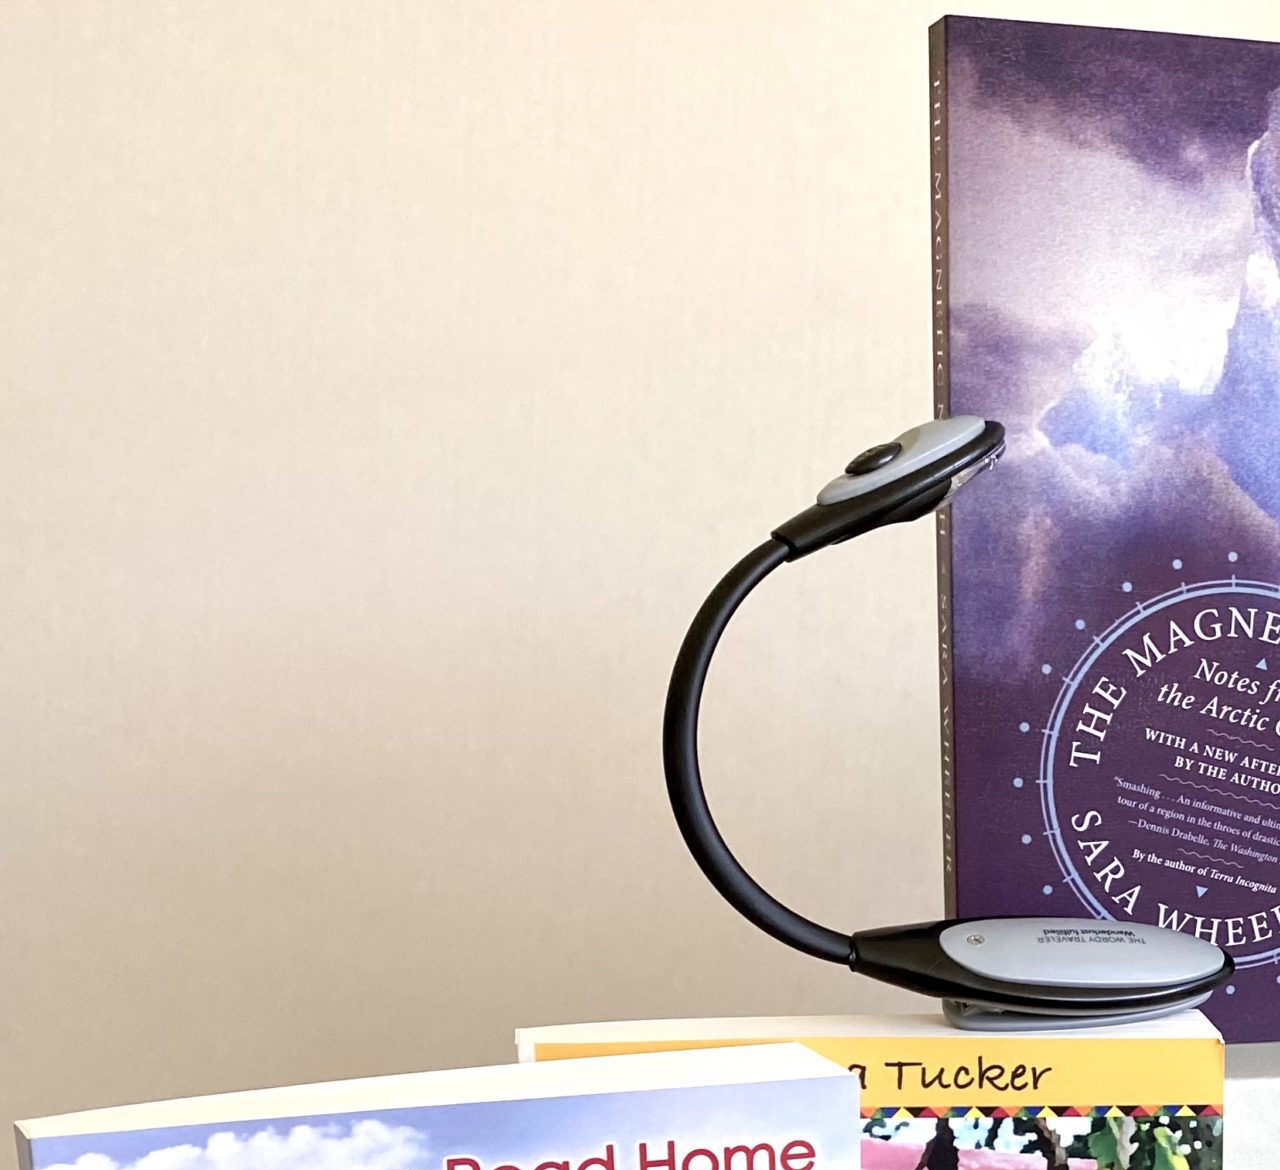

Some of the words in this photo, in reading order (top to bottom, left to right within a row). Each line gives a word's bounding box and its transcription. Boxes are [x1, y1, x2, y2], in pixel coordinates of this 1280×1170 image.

[1193, 658, 1260, 695] Notes
[1069, 676, 1127, 768] THE
[1157, 683, 1196, 710] the
[1199, 696, 1270, 731] Arctic
[1145, 728, 1187, 750] WITH
[1189, 741, 1199, 754] A
[1203, 744, 1238, 763] NEW
[1174, 755, 1195, 771] BY
[1198, 762, 1228, 781] THE
[1117, 795, 1138, 808] tour
[1138, 802, 1150, 811] of
[1157, 807, 1185, 821] region
[1186, 813, 1196, 824] in
[1197, 817, 1212, 828] the
[1213, 821, 1241, 836] throes
[1242, 829, 1254, 839] of
[1252, 831, 1280, 847] drastic
[1175, 795, 1191, 806] An
[1192, 799, 1242, 820] informative
[1243, 815, 1261, 825] and
[1071, 810, 1142, 916] SARA
[1213, 838, 1229, 851] The
[1230, 843, 1278, 862] Washington
[1132, 849, 1146, 863] By
[1147, 852, 1163, 865] the
[1164, 859, 1195, 874] author
[1197, 866, 1209, 877] of
[1210, 868, 1234, 883] Terra
[1235, 874, 1278, 894] Incognita
[884, 1056, 1053, 1091] Tucker
